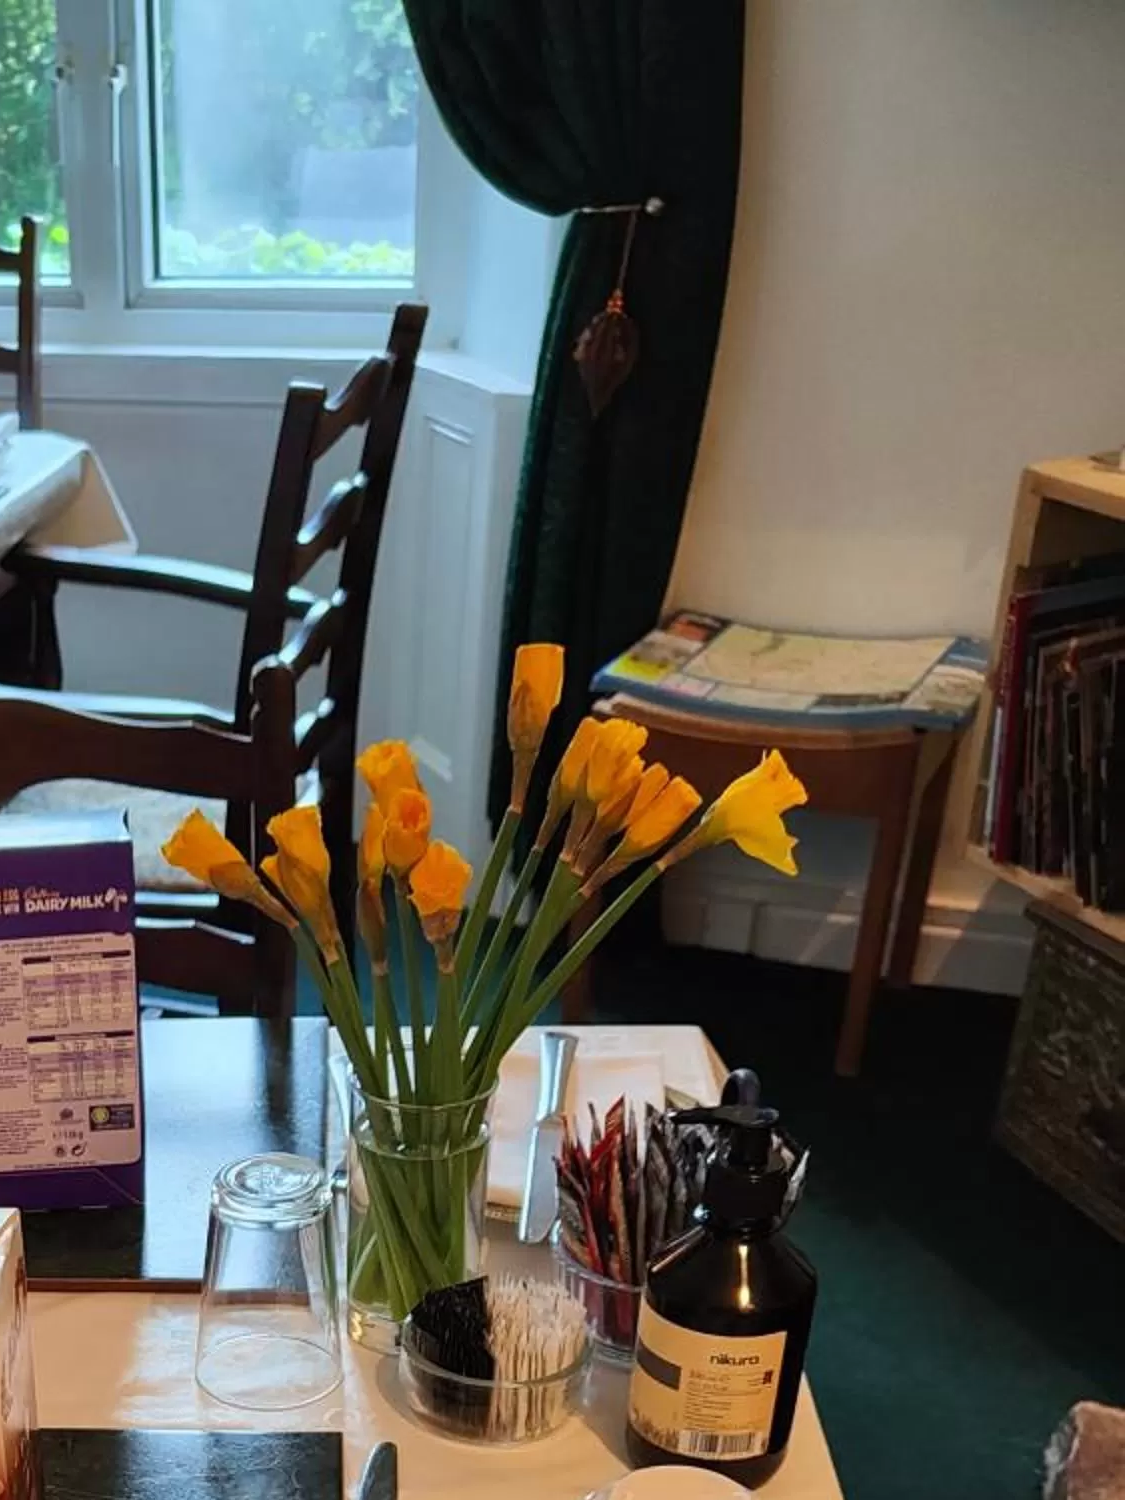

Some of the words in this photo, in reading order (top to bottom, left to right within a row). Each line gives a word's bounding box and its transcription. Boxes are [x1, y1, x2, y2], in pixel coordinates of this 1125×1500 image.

[25, 897, 68, 913] DAIRY
[70, 894, 105, 911] MILK
[709, 1353, 760, 1366] nikura
